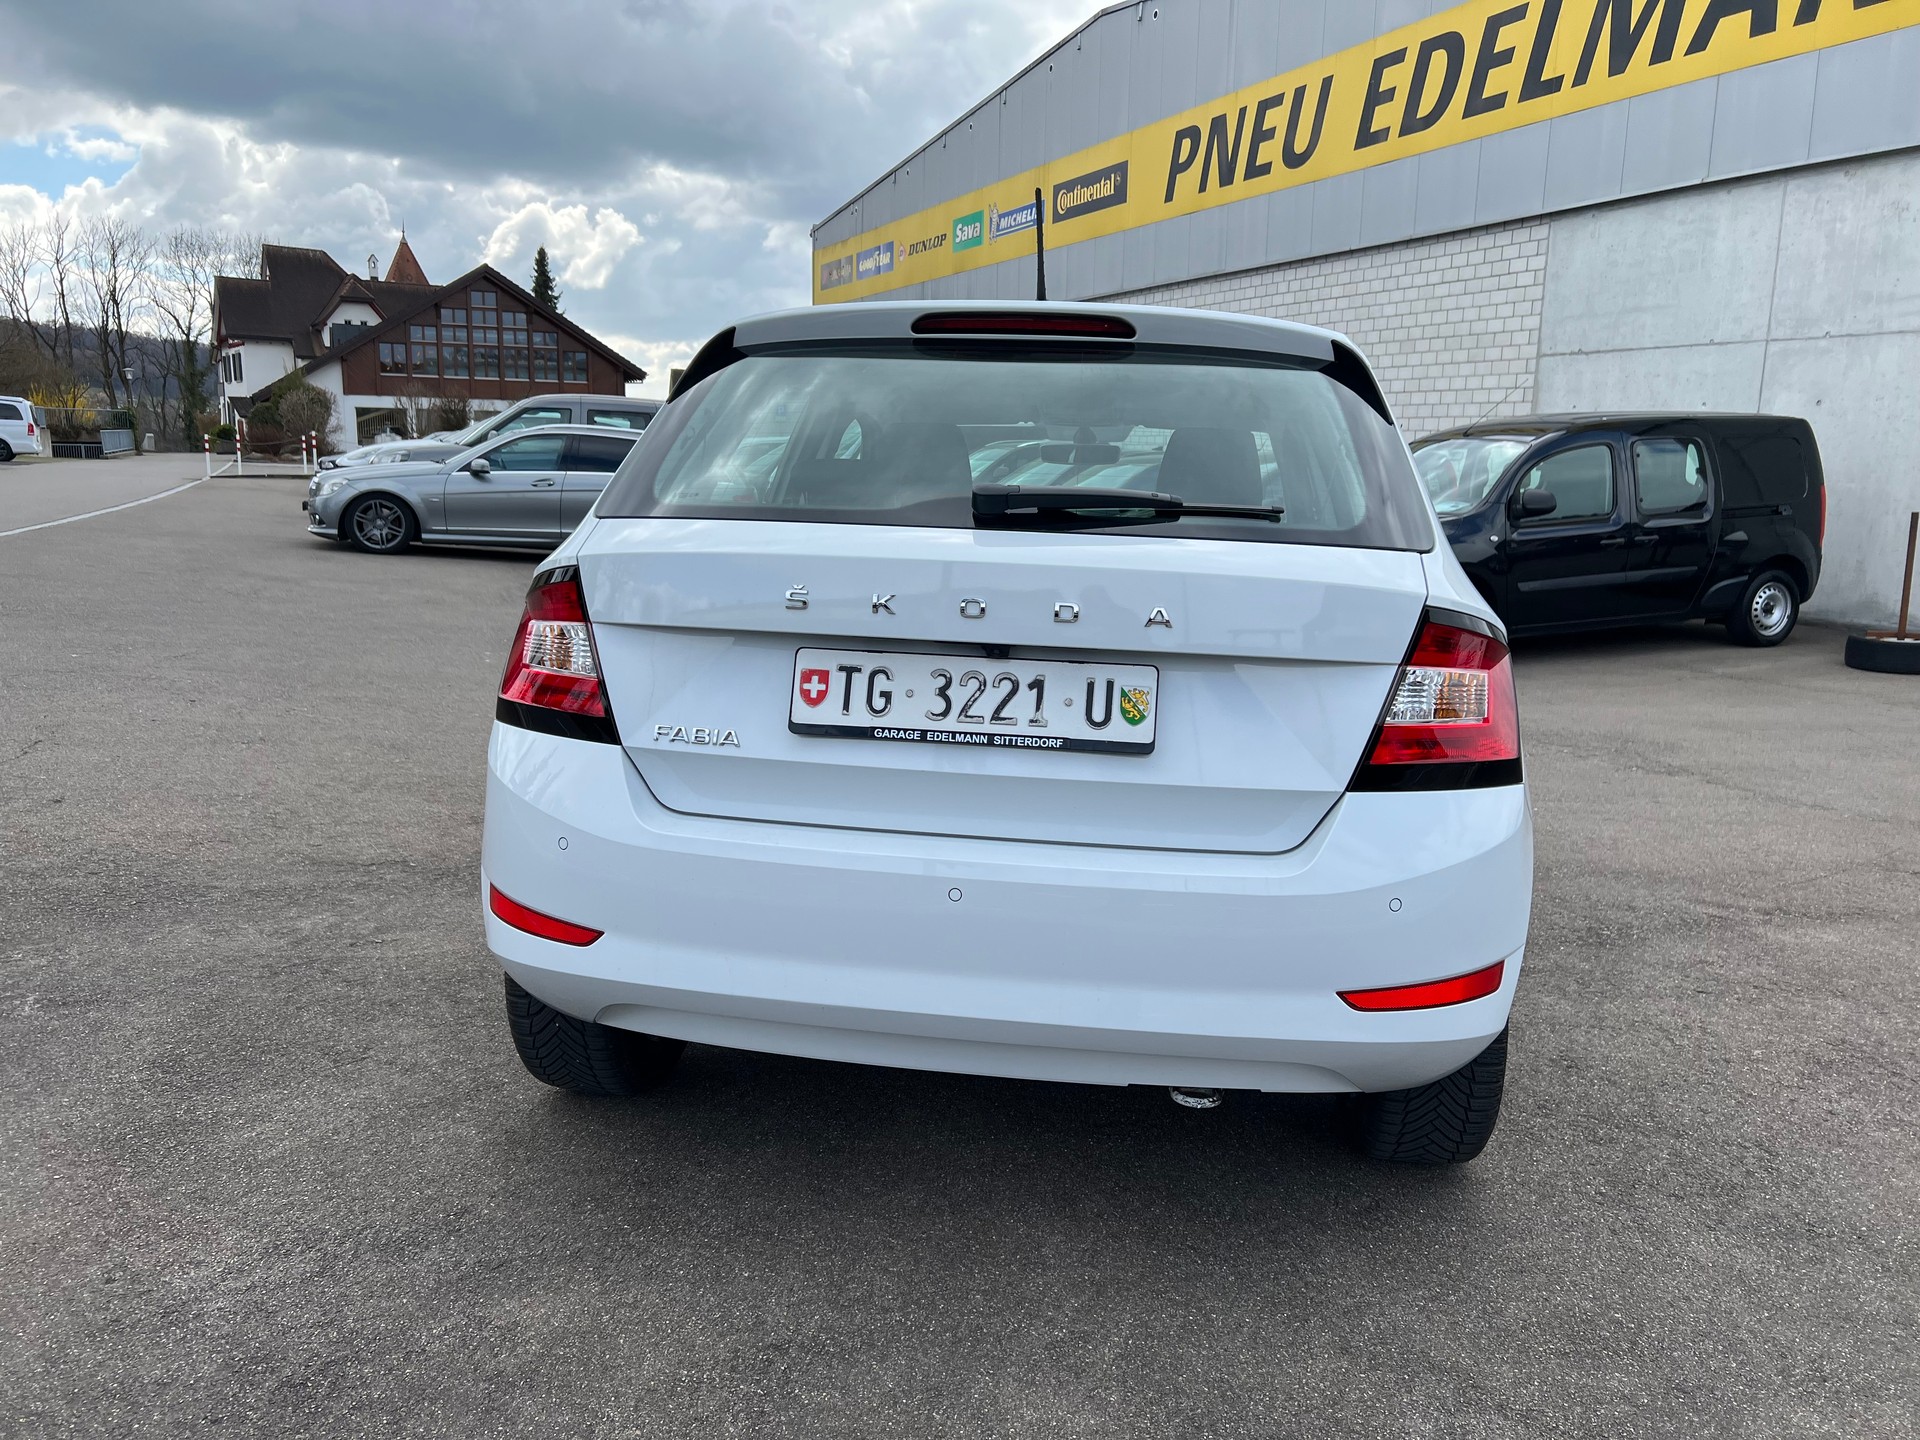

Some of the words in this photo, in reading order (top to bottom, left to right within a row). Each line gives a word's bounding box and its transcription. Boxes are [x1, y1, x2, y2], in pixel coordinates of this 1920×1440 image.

[1164, 74, 1335, 204] PNEU
[1353, 0, 1890, 151] EDELM
[1057, 173, 1115, 215] Continental
[999, 207, 1037, 230] MICHELI
[907, 233, 947, 256] DUNLOP
[955, 222, 981, 244] Sava
[836, 663, 895, 718] TG
[925, 668, 1049, 728] 3221
[1084, 677, 1115, 731] U
[652, 723, 743, 748] FABIA
[873, 727, 922, 741] GARAGE
[926, 731, 988, 745] EDELMANN
[992, 734, 1064, 749] SITTERDORF
